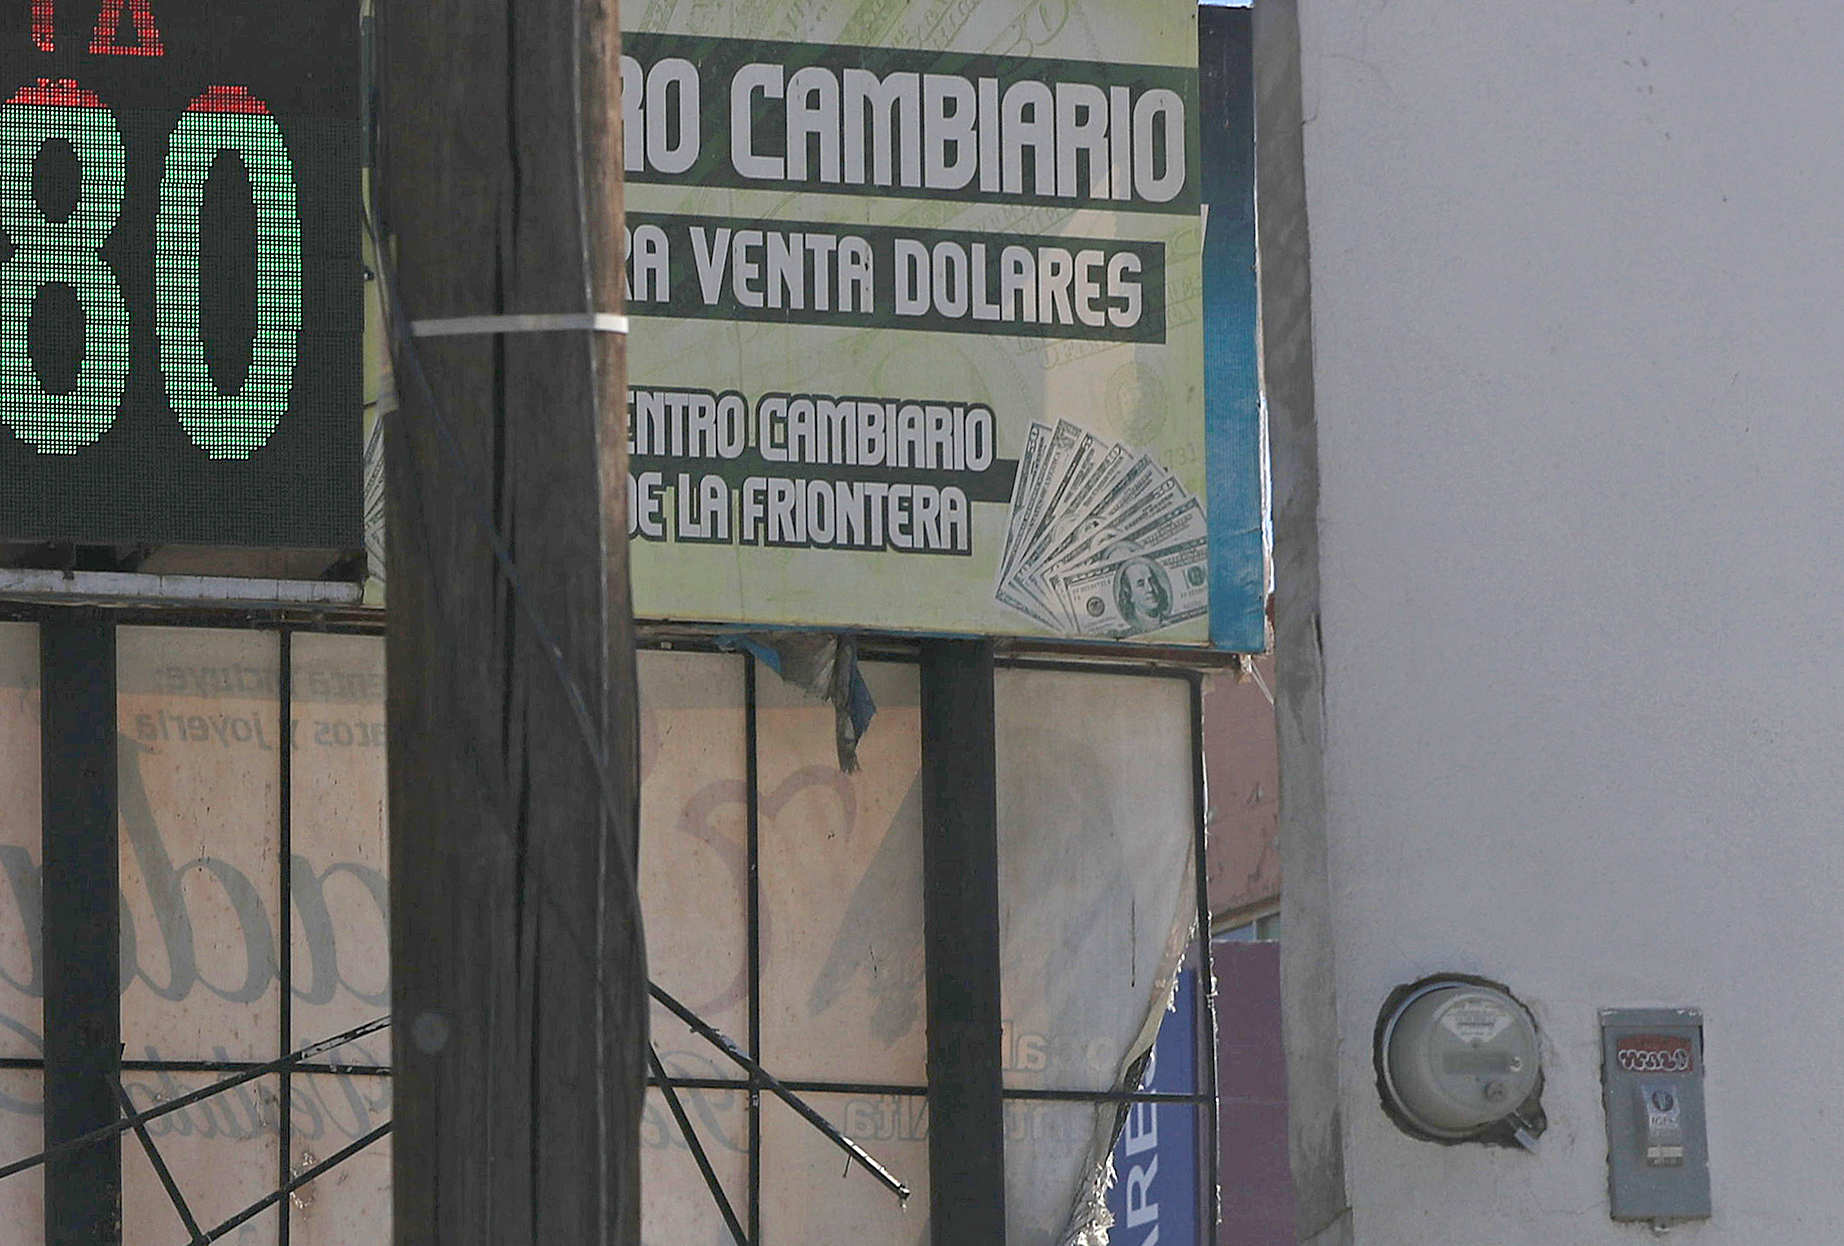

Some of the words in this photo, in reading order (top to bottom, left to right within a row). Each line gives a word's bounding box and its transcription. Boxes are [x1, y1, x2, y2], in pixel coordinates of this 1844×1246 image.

[730, 62, 1187, 203] CAMBIARIO
[689, 225, 874, 315] VENTA
[894, 238, 1142, 327] DOLARES
[759, 397, 994, 472] CAMBIARIO
[678, 473, 729, 539] LA
[743, 477, 969, 551] FRIONTERA
